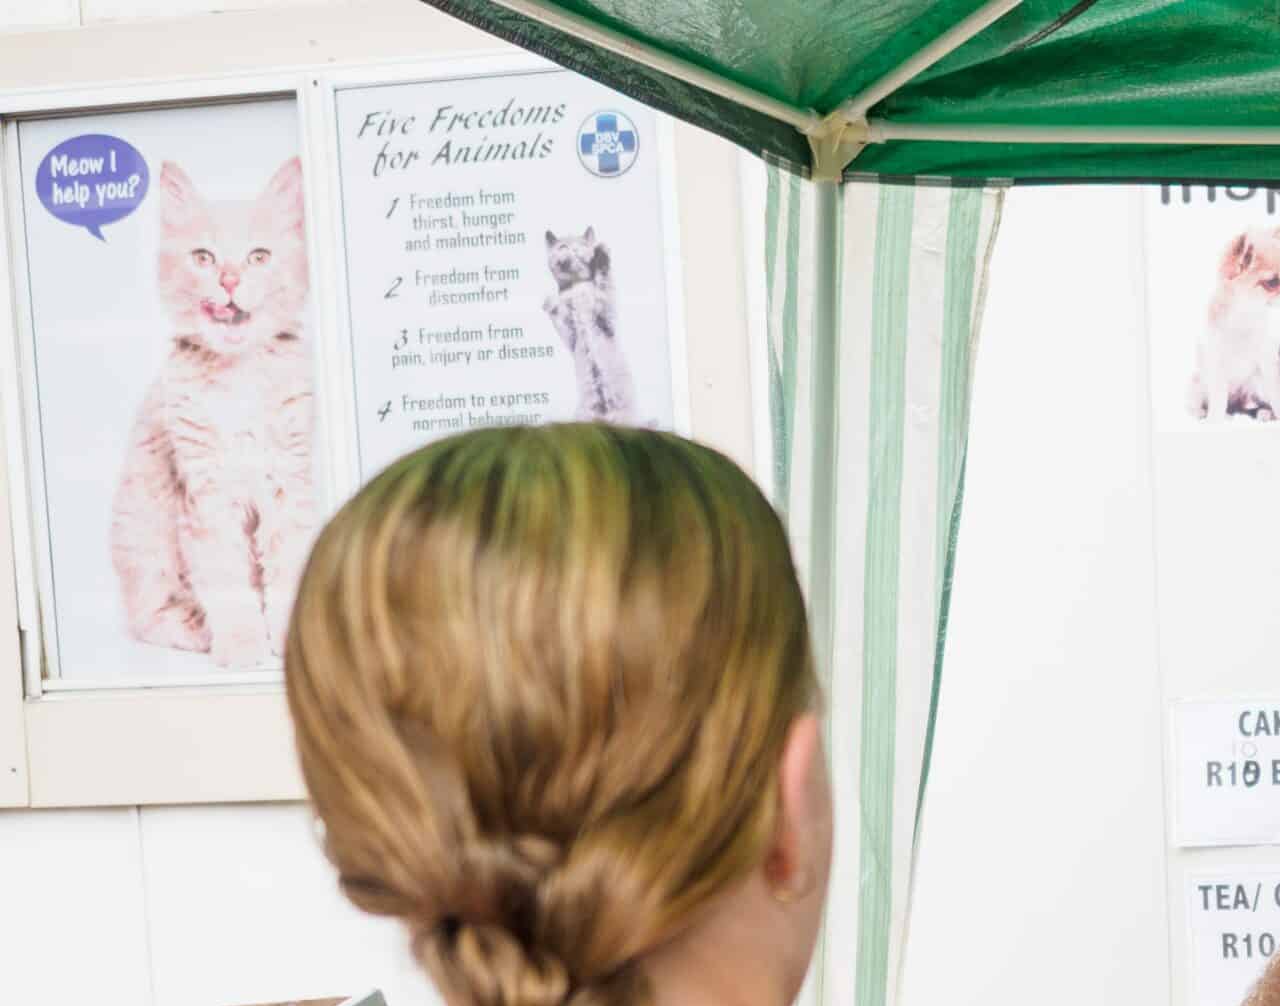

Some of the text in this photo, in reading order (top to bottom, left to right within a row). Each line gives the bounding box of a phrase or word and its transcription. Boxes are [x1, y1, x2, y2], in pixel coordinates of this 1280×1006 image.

[357, 98, 567, 138] Five Freedoms
[372, 133, 554, 177] for Animals
[592, 141, 624, 154] SPCA
[50, 149, 117, 178] Meow I
[52, 174, 140, 208] help you?
[409, 192, 474, 210] Freedom
[480, 188, 515, 206] from
[462, 210, 515, 229] hunger
[405, 230, 525, 252] and malnutrition
[384, 266, 519, 299] 2 Freedom from
[428, 287, 509, 307] discomfort
[394, 323, 523, 351] 3 Freedom from
[430, 346, 472, 367] injury
[477, 347, 494, 361] or
[497, 343, 553, 360] disease
[377, 391, 549, 422] 4 Freedom to express
[412, 410, 463, 431] normal
[1198, 882, 1262, 913] TEA/
[1221, 932, 1275, 960] R10
